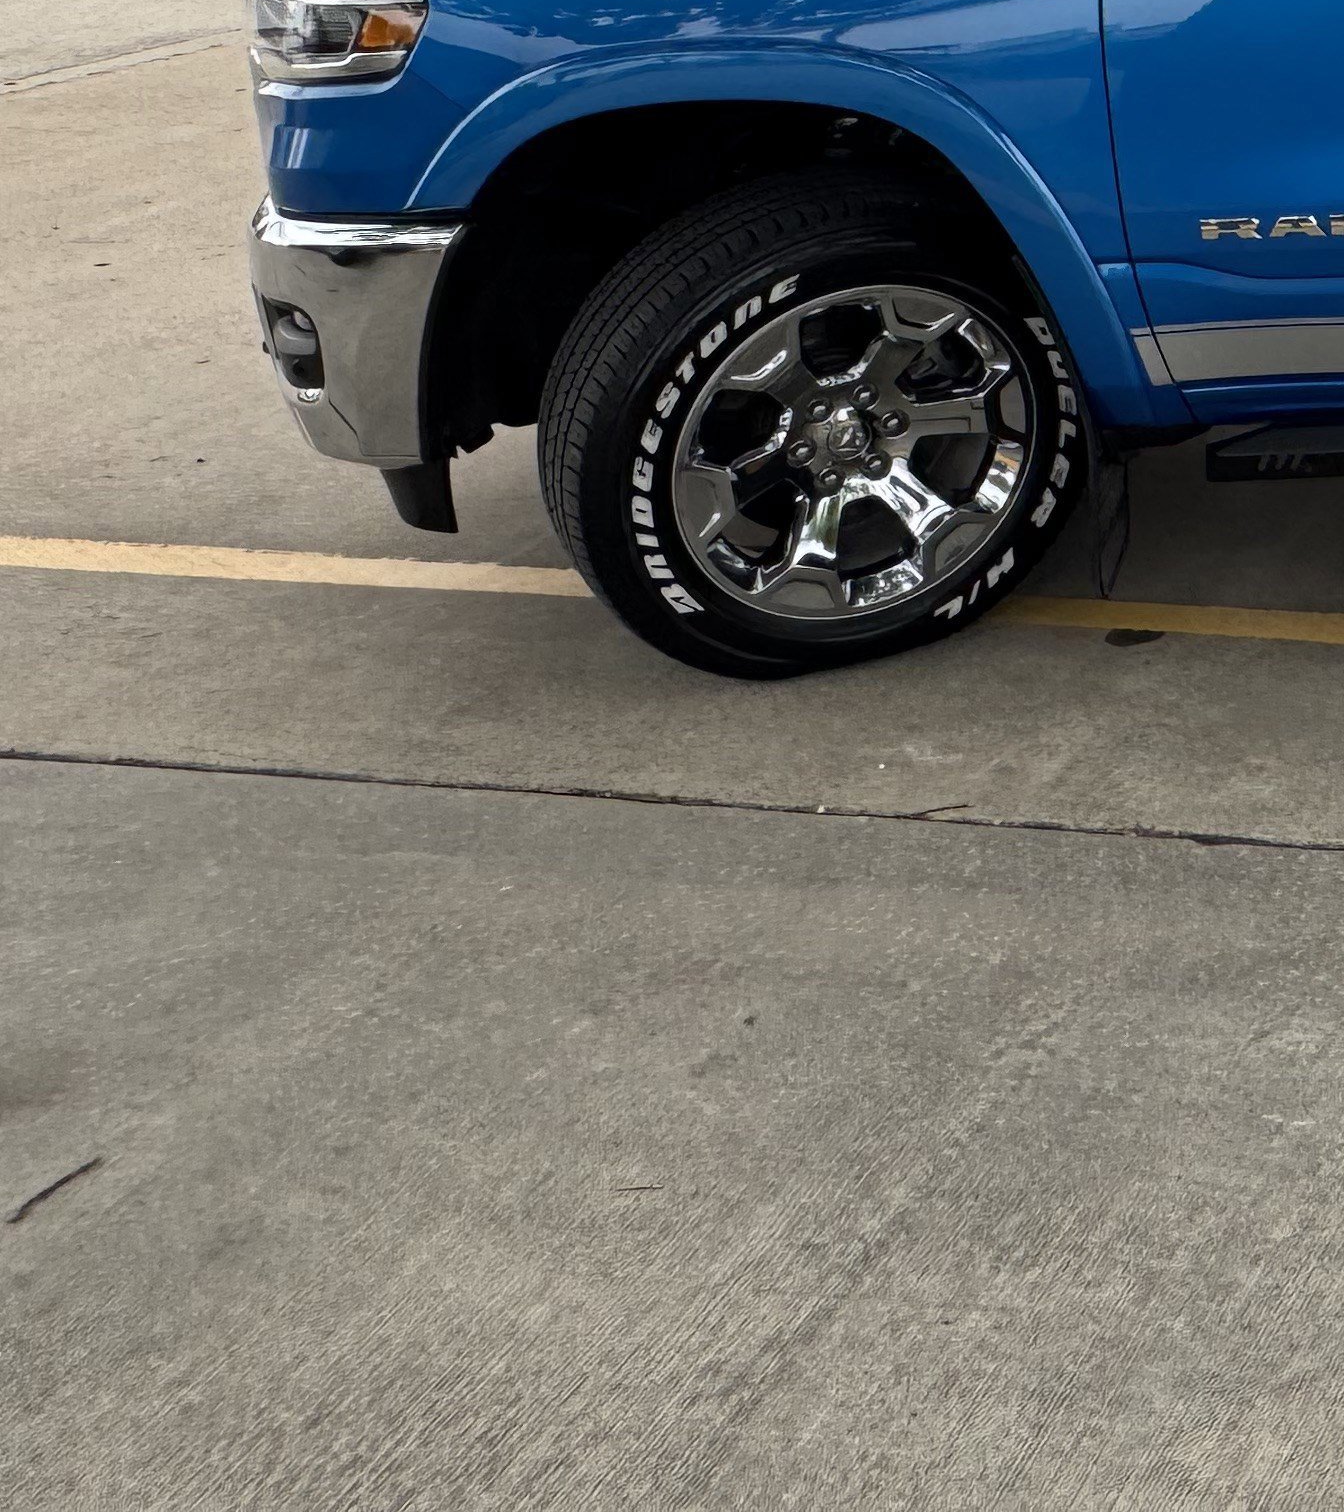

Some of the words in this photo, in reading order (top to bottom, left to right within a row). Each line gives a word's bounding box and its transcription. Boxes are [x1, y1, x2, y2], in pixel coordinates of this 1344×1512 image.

[631, 274, 799, 615] BRIDGESTONE
[1024, 317, 1077, 528] DUELER
[934, 549, 1015, 619] H/L
